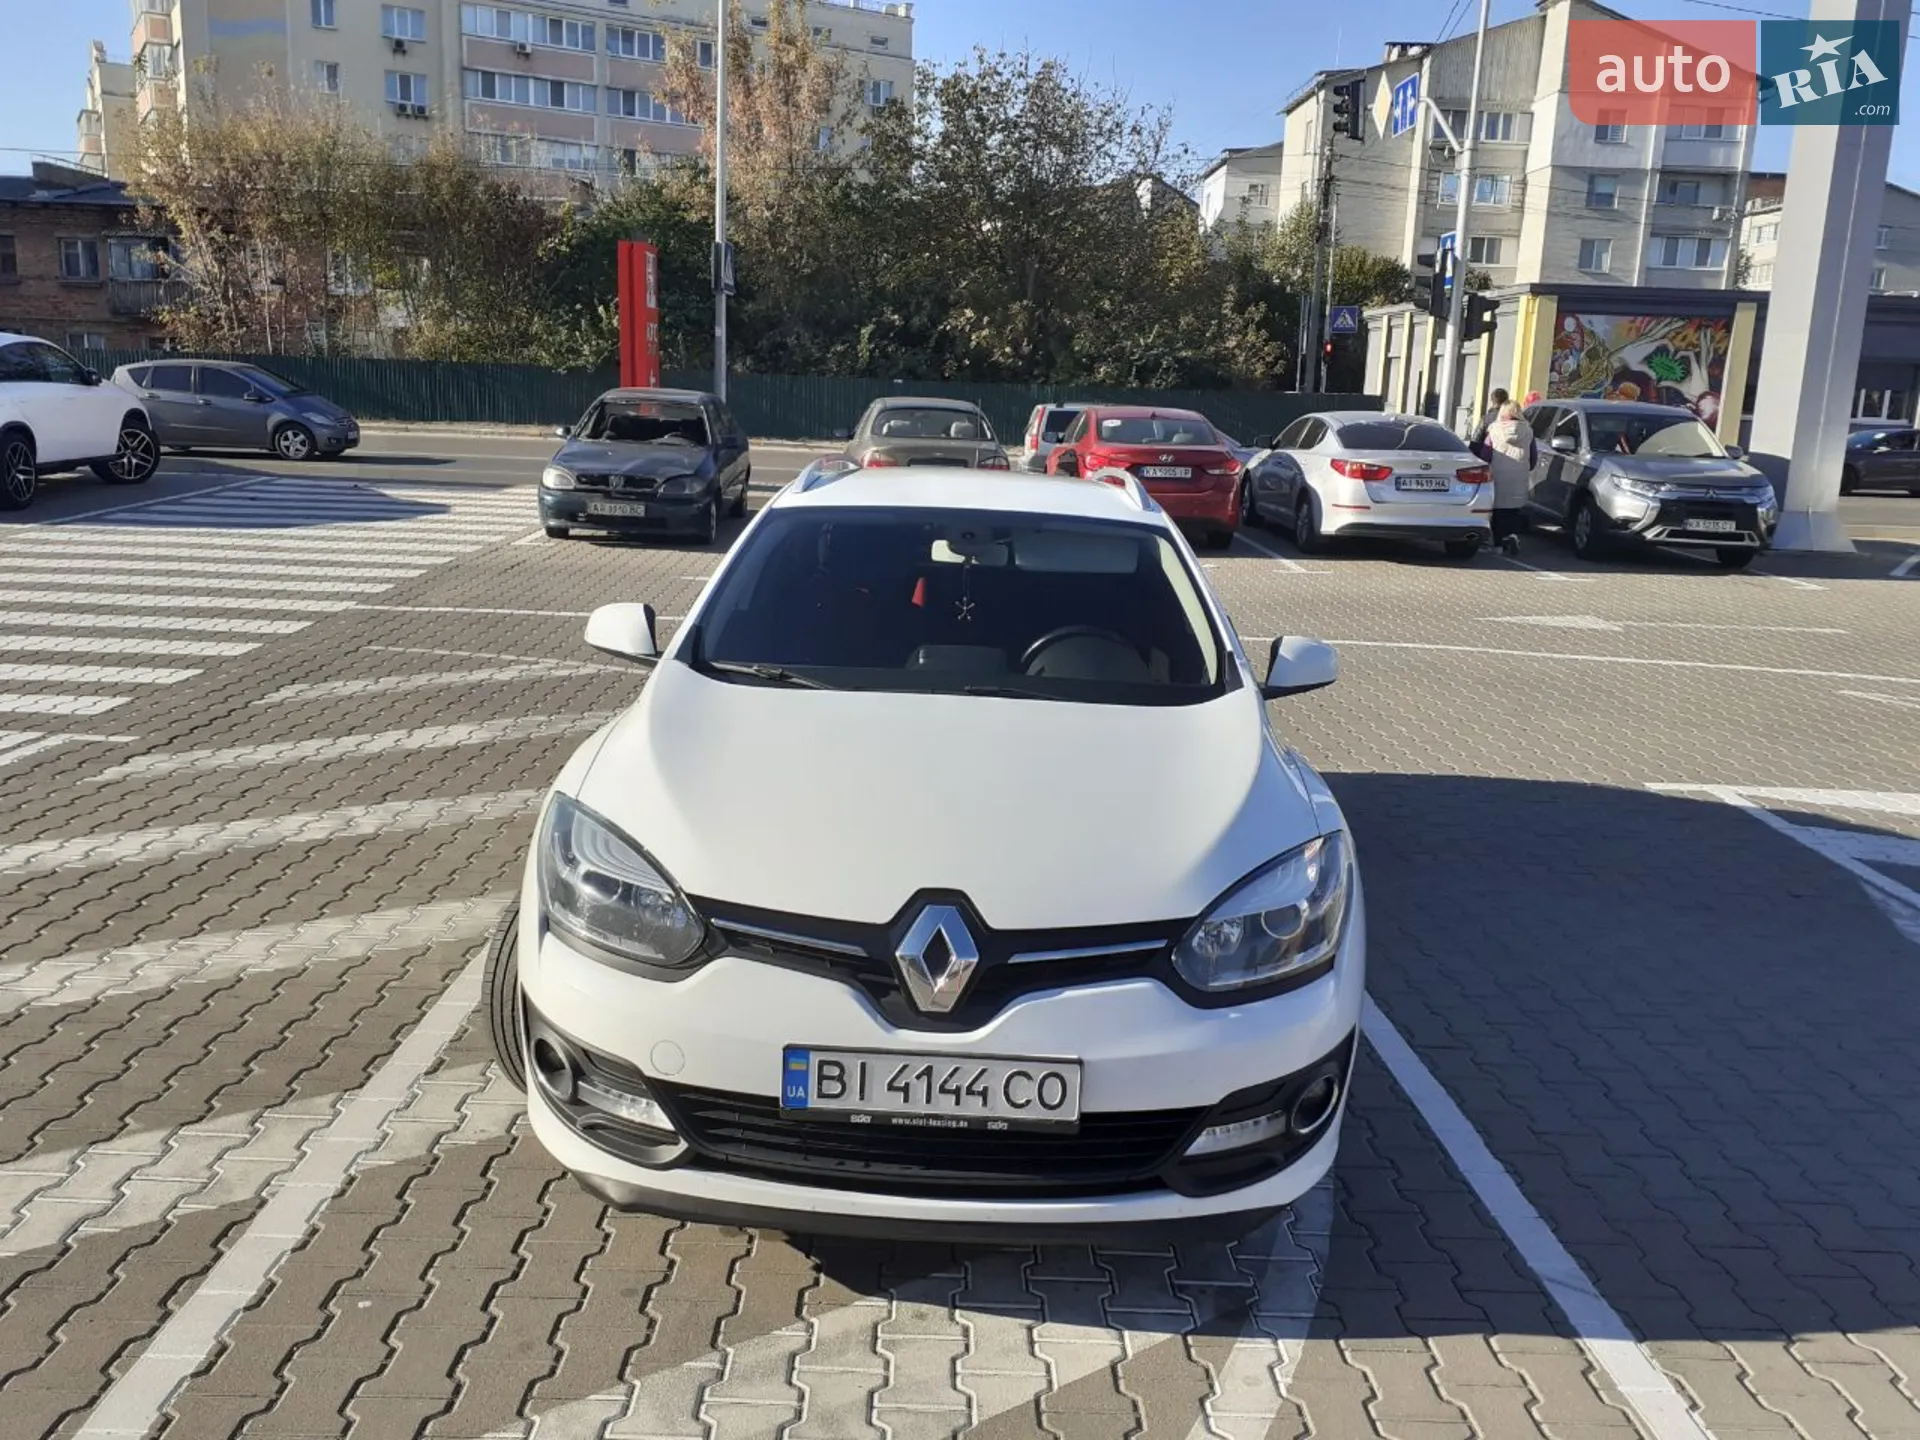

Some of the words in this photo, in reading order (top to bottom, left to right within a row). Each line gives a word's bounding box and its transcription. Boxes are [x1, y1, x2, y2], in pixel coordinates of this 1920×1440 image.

[787, 1086, 805, 1099] UA
[815, 1059, 867, 1101] BI
[886, 1063, 988, 1108] 4144
[1002, 1069, 1068, 1112] CO
